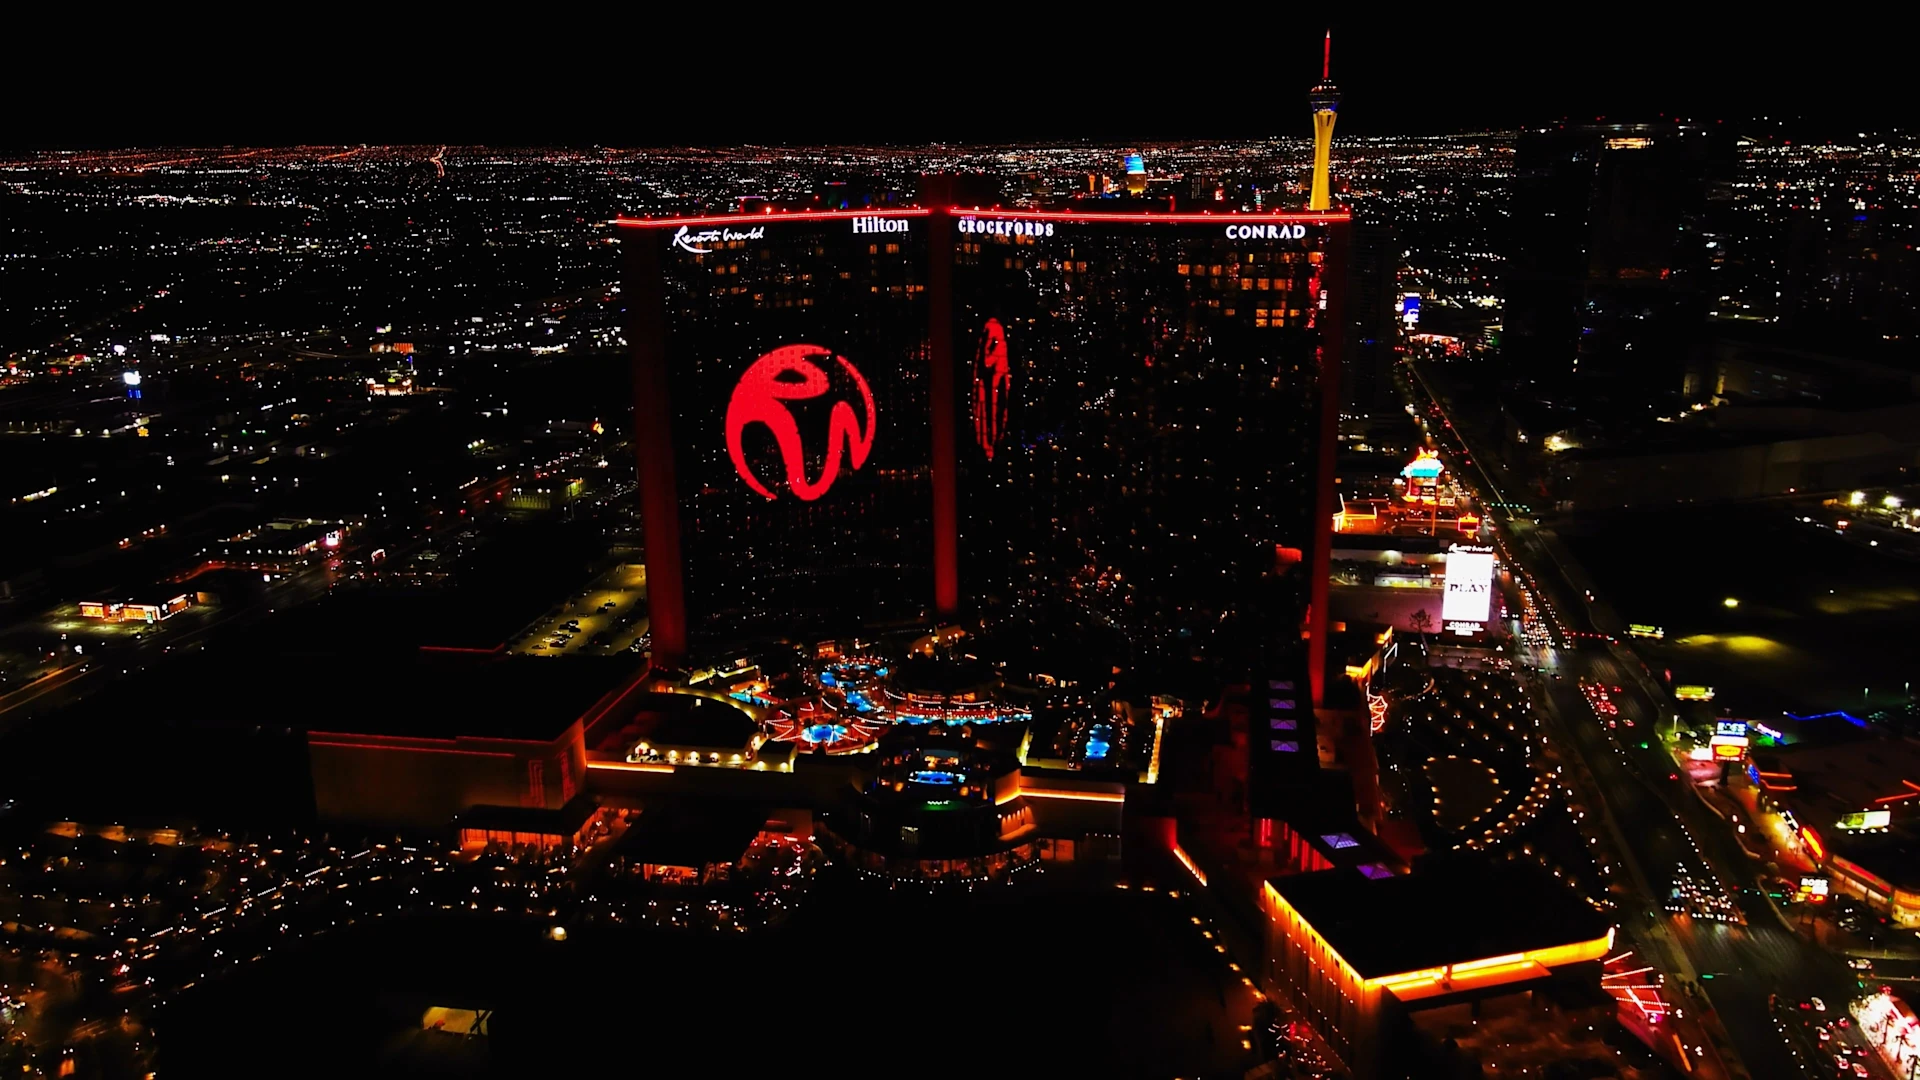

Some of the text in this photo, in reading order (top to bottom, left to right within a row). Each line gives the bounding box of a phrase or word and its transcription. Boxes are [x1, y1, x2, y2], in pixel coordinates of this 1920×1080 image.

[852, 216, 909, 233] Hilton
[958, 219, 1054, 237] CROCKFORDS
[1225, 224, 1306, 240] CONRAD
[672, 225, 764, 253] Resorts World
[1449, 583, 1488, 593] PLAY
